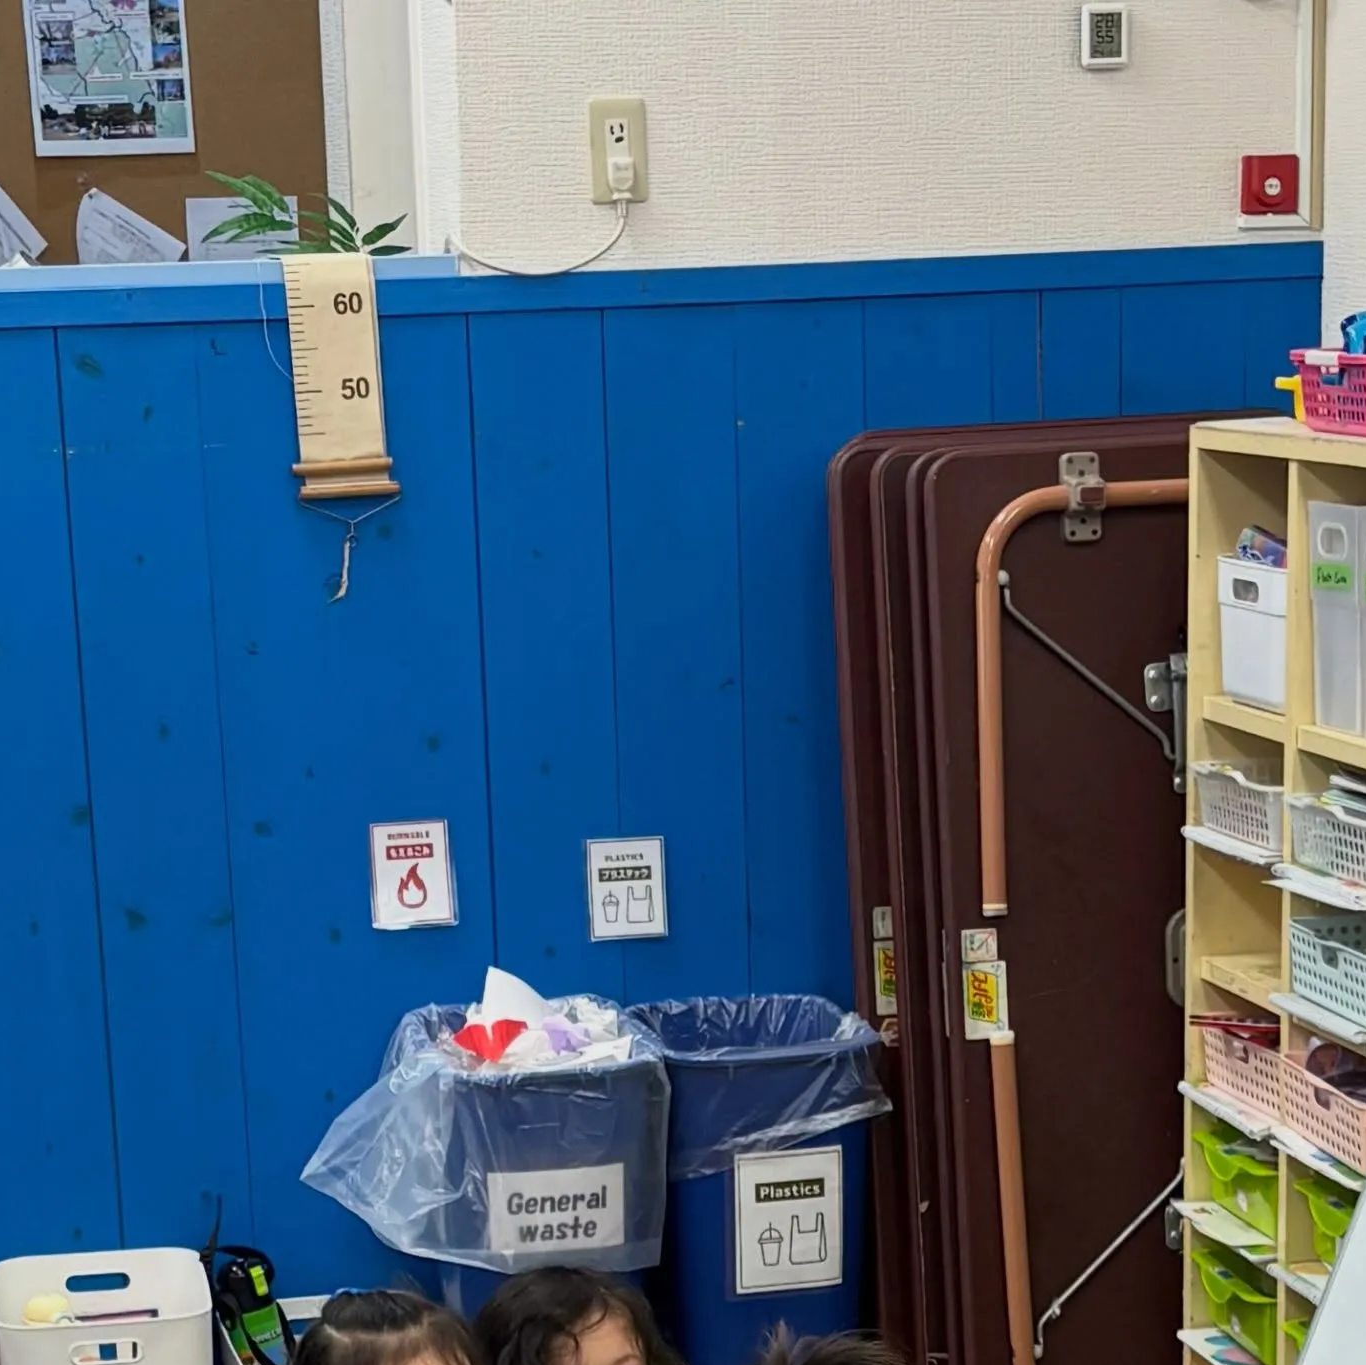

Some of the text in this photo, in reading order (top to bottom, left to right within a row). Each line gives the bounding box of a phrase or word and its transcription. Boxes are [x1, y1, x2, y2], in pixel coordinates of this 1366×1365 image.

[1096, 30, 1114, 44] 55
[334, 292, 363, 315] 60
[341, 377, 370, 400] 50
[506, 1185, 607, 1216] General
[760, 1183, 821, 1200] Plastics
[518, 1216, 598, 1243] waste
